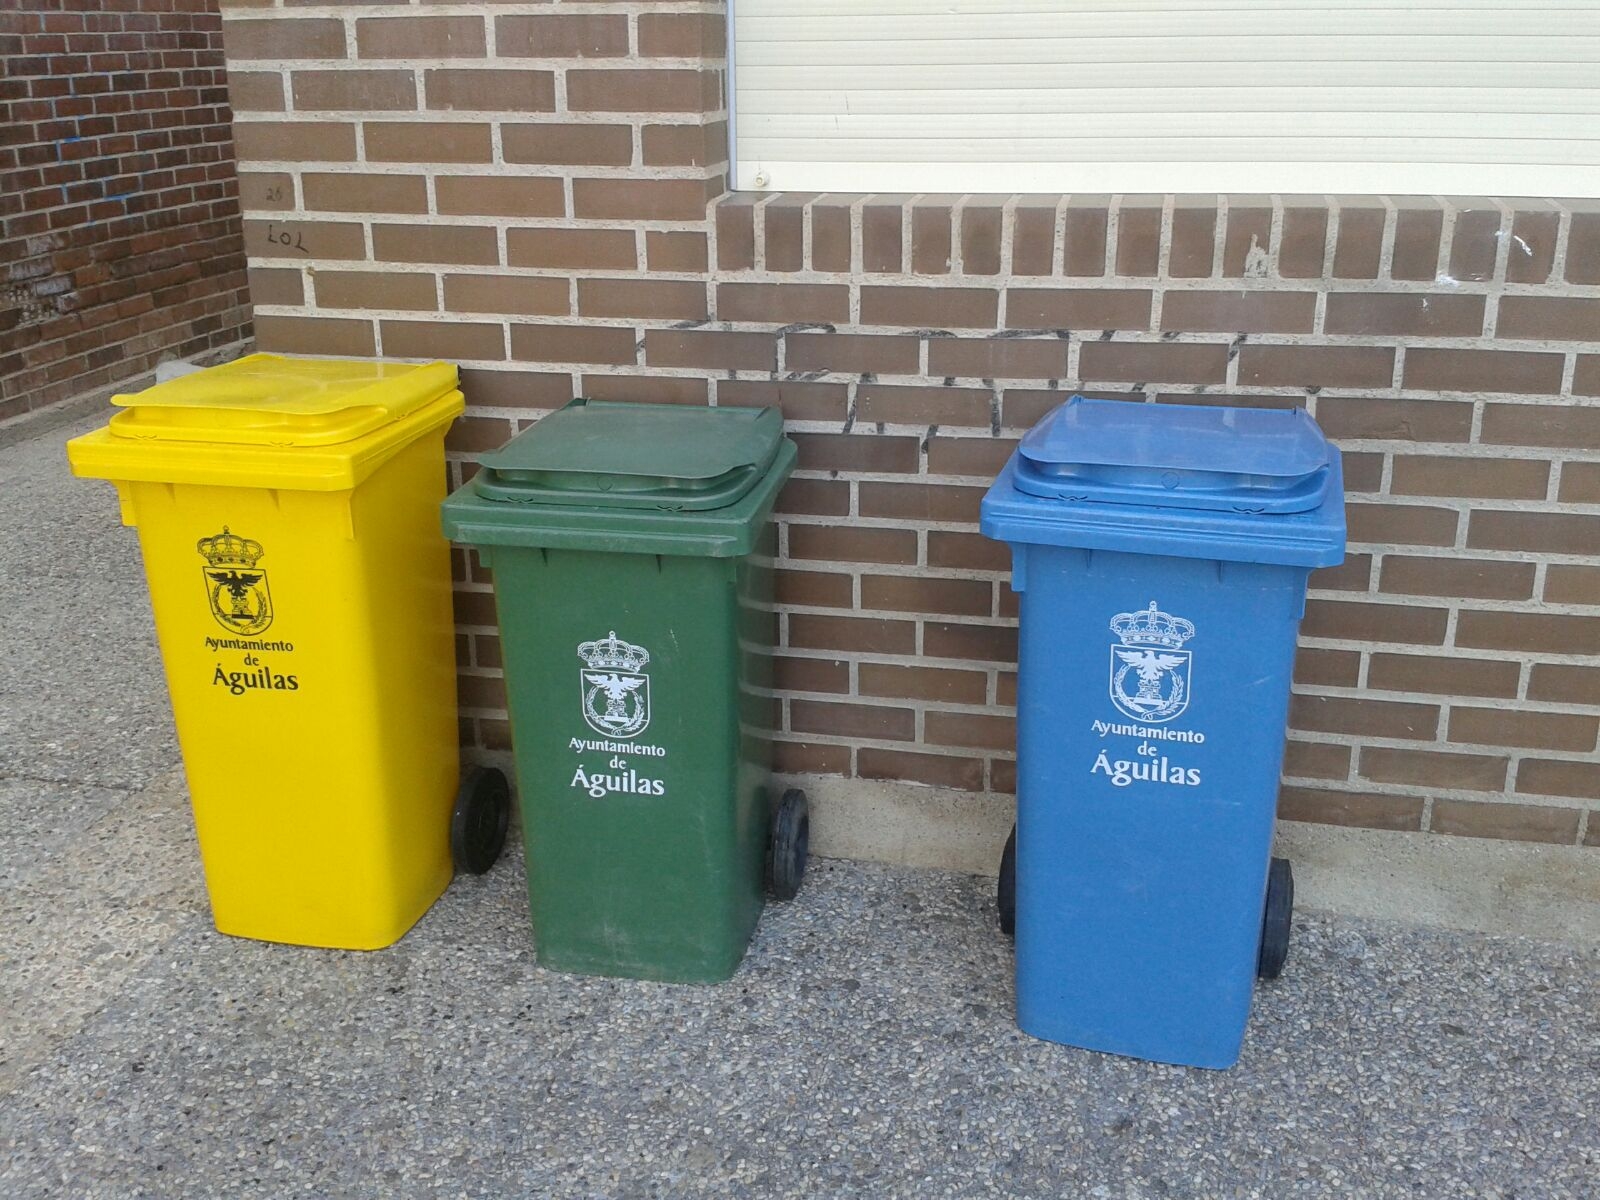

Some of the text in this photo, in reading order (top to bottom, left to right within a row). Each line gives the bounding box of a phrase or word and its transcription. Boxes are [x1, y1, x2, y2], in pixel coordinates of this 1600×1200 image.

[267, 224, 310, 254] LOL
[205, 636, 294, 652] Ayuntamiento
[243, 653, 260, 667] de
[213, 663, 299, 696] Águilas
[1090, 719, 1205, 744] Ayuntamiento
[568, 737, 666, 757] Ayuntamiento
[1137, 740, 1157, 756] de
[609, 755, 627, 769] de
[1090, 749, 1201, 787] Águilas
[570, 764, 665, 798] Águilas
